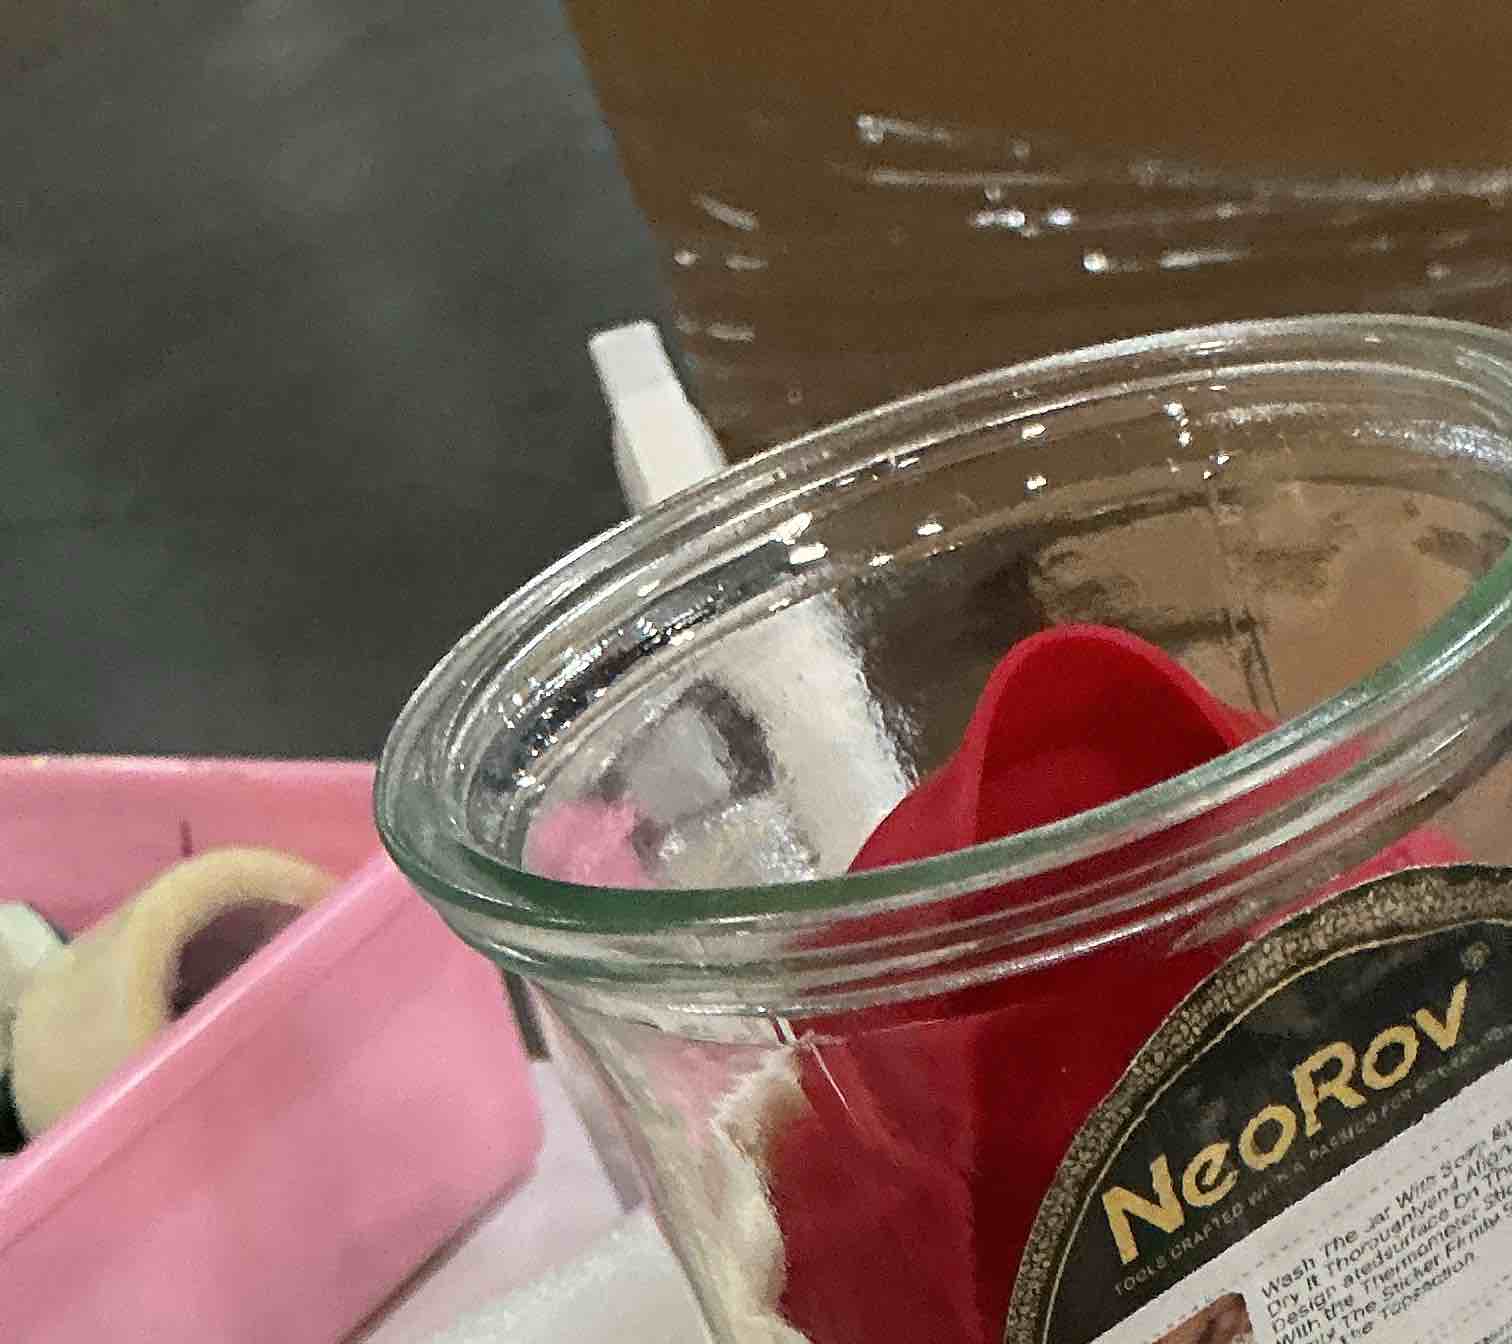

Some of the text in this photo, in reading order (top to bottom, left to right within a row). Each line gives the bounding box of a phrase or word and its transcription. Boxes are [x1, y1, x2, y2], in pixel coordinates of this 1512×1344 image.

[1102, 979, 1468, 1263] NeoRov
[1169, 1203, 1245, 1258] CRAFTED
[1261, 1256, 1315, 1298] Wash
[1323, 1229, 1359, 1259] The
[1382, 1256, 1446, 1302] Sticker
[1267, 1289, 1301, 1318] Dry
